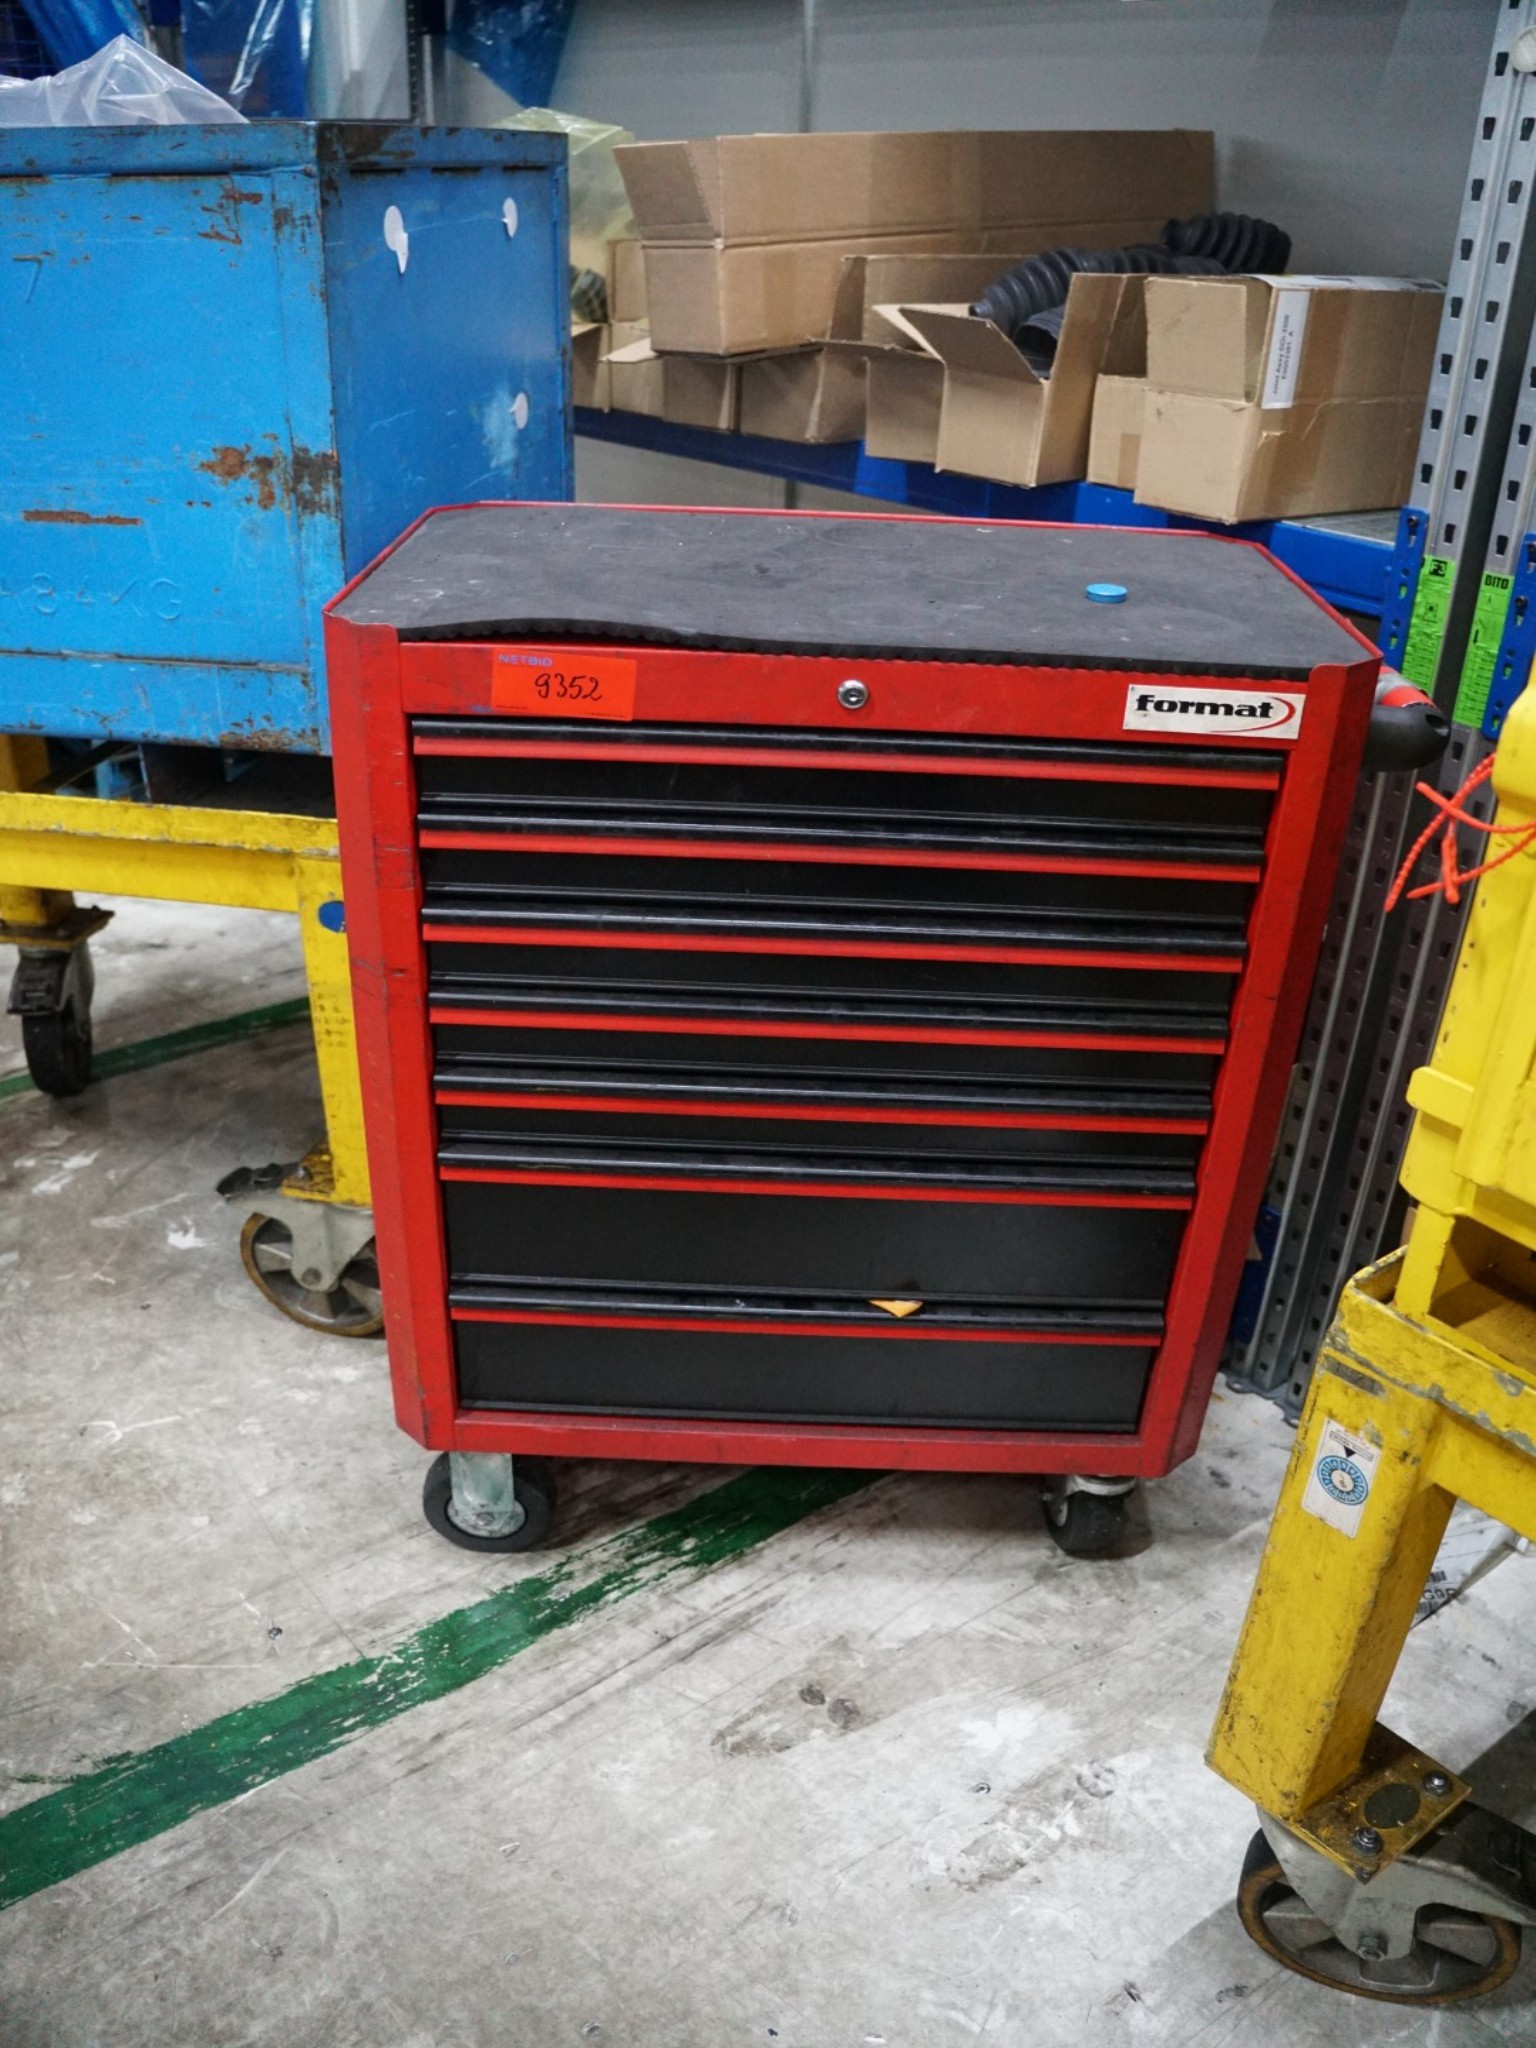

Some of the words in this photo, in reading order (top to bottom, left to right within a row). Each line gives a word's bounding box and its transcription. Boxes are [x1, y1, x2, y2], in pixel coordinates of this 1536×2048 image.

[1484, 574, 1510, 590] BITO
[534, 673, 602, 701] 9352
[1135, 694, 1274, 718] format
